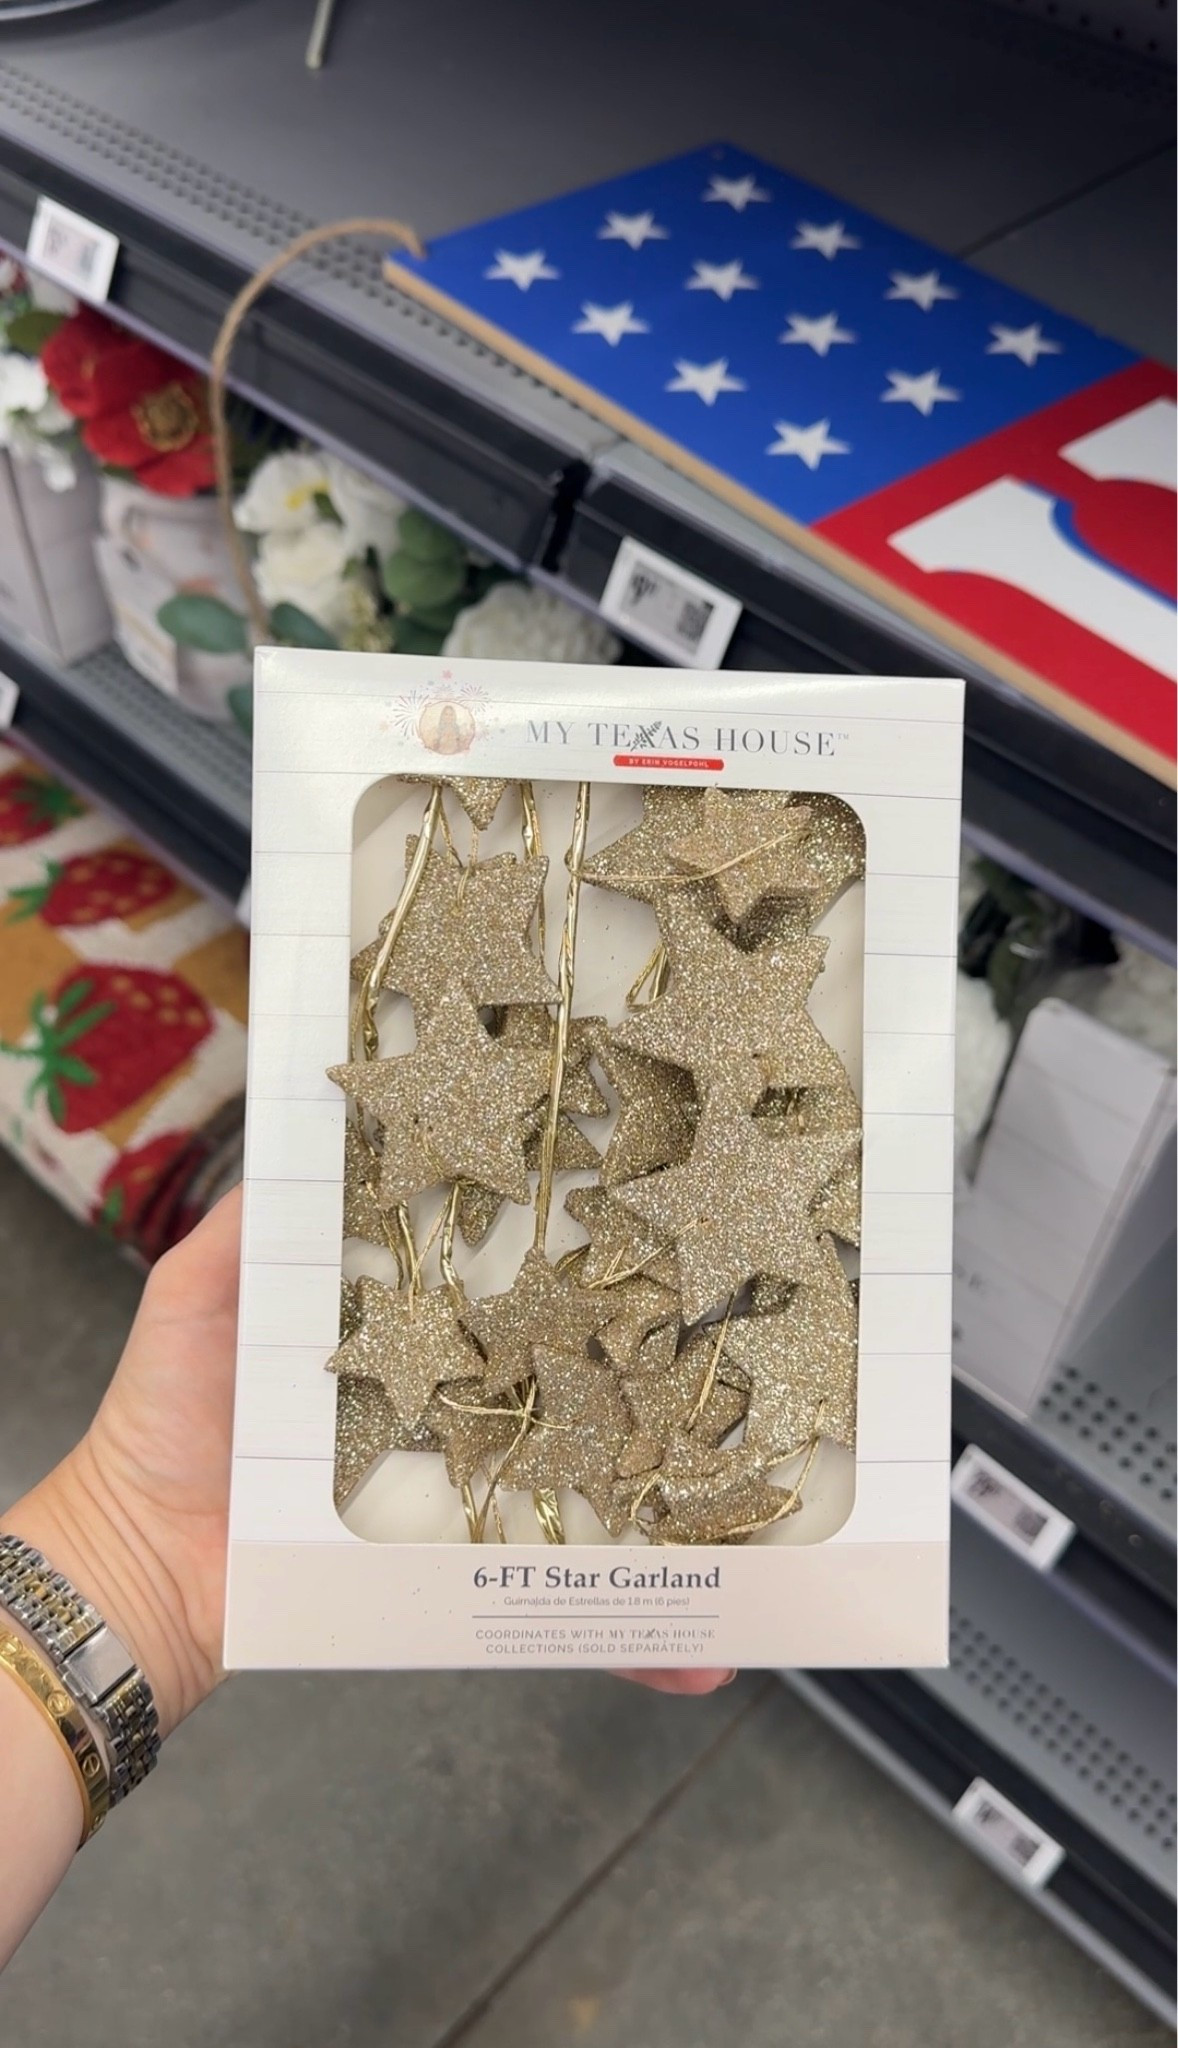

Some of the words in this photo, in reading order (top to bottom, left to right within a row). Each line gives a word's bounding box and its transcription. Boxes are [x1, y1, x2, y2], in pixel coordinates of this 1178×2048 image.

[526, 720, 575, 745] MY
[588, 721, 700, 751] TEXAS
[642, 758, 661, 766] ERIN
[473, 1565, 536, 1588] 6-FT
[545, 1566, 600, 1588] Star
[609, 1566, 721, 1588] Garland
[553, 1596, 566, 1606] de
[568, 1596, 610, 1606] Estrellas
[612, 1597, 626, 1606] de
[642, 1598, 653, 1606] m
[475, 1629, 566, 1640] COORDINATES
[570, 1629, 603, 1639] WITH
[609, 1629, 625, 1639] MY
[630, 1628, 669, 1639] TEXAS
[673, 1629, 715, 1639] HOUSE
[485, 1643, 574, 1654] COLLECTIONS
[578, 1643, 616, 1653] (SOLD
[620, 1643, 704, 1653] SEPARATELY)
